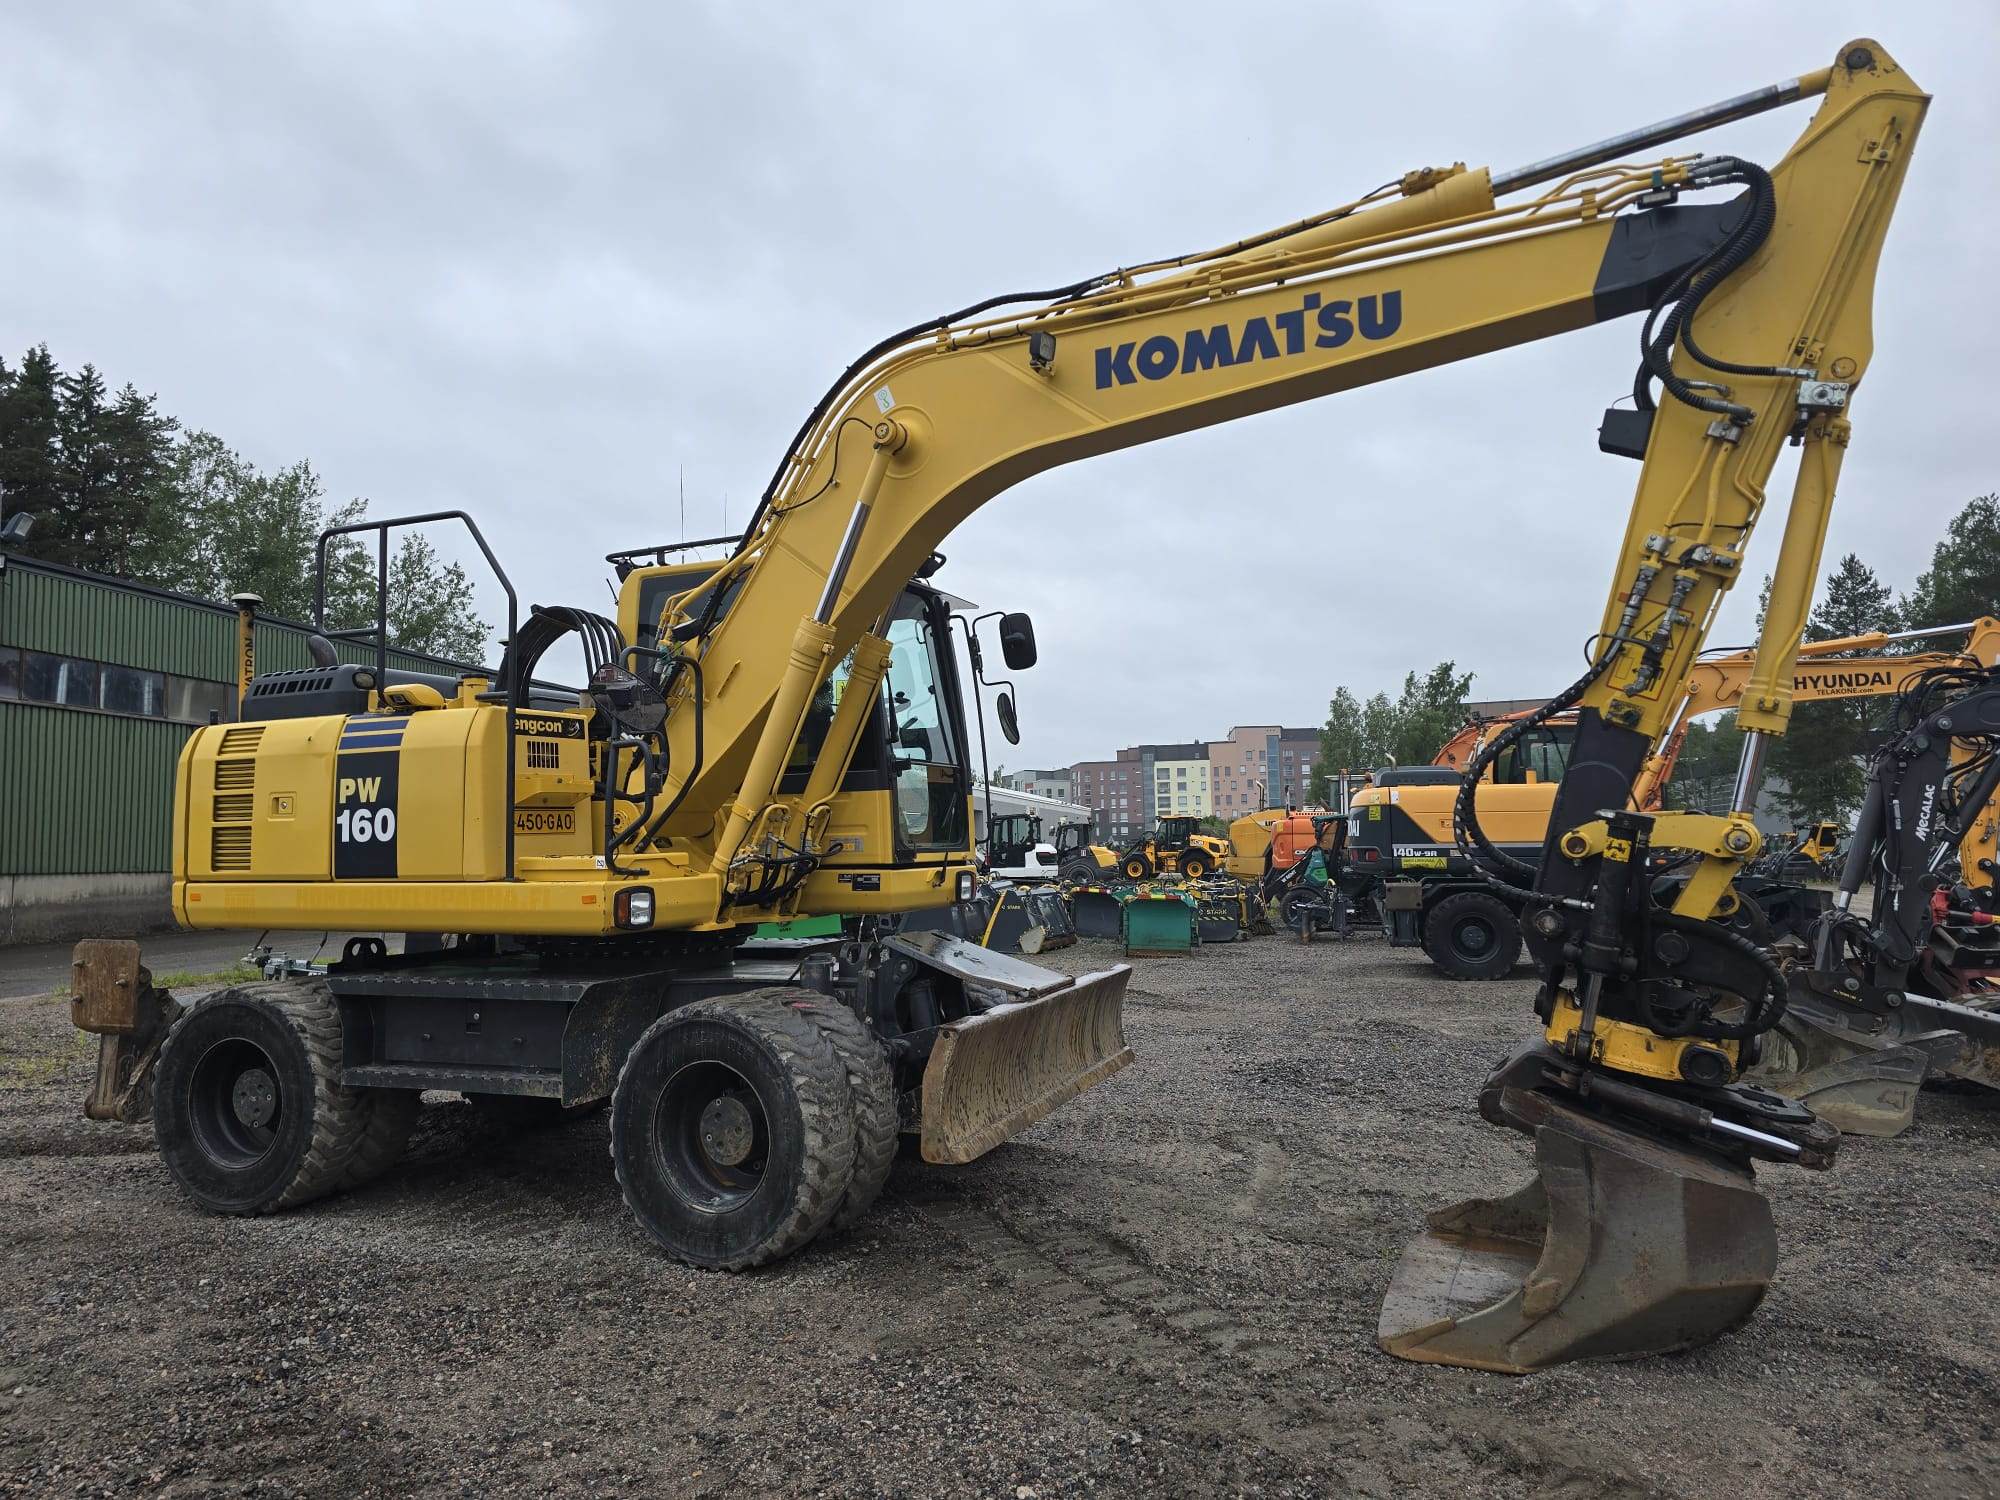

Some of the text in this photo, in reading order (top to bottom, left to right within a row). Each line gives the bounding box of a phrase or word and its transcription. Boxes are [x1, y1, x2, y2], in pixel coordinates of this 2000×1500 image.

[1095, 290, 1402, 390] KOMATSU
[1793, 671, 1892, 690] HYUNDAI
[1816, 687, 1874, 696] TELAKONE.com
[339, 776, 382, 804] PW
[336, 807, 396, 843] 160
